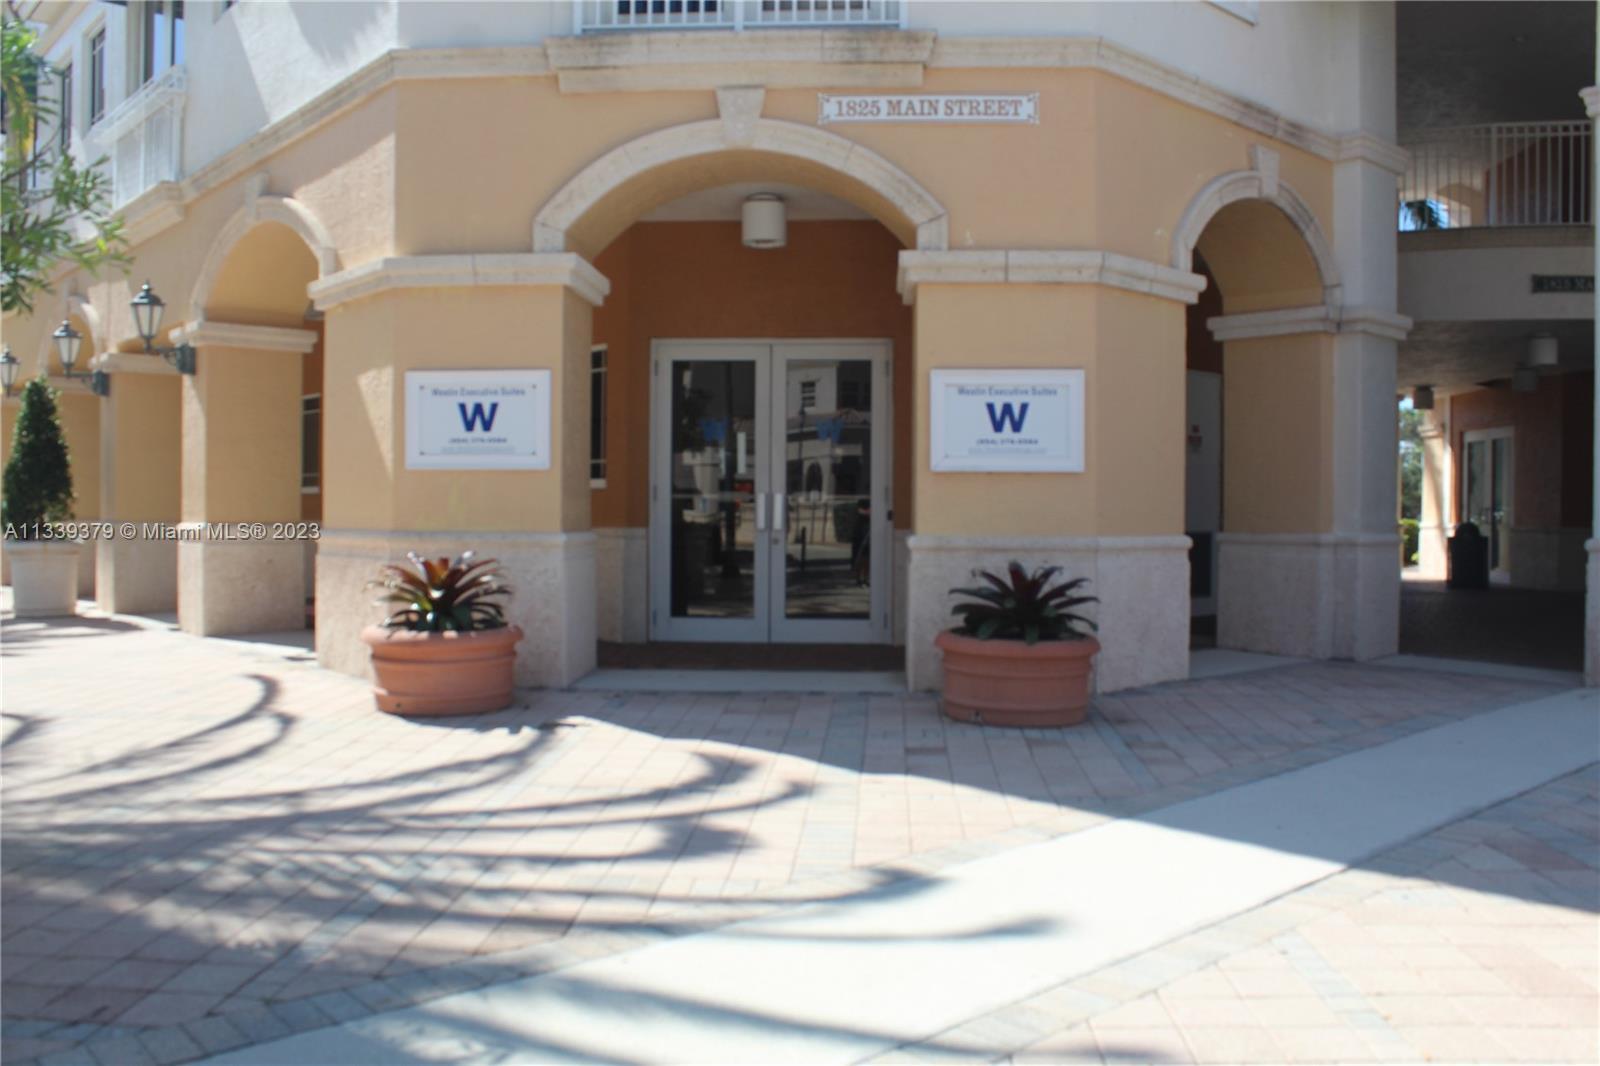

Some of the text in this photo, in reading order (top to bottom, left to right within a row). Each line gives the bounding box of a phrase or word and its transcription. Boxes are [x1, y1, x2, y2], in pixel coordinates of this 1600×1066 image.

[835, 98, 1024, 117] 1825 MAIN STREET
[989, 386, 1029, 396] Executive
[457, 402, 499, 432] W
[985, 402, 1029, 433] W
